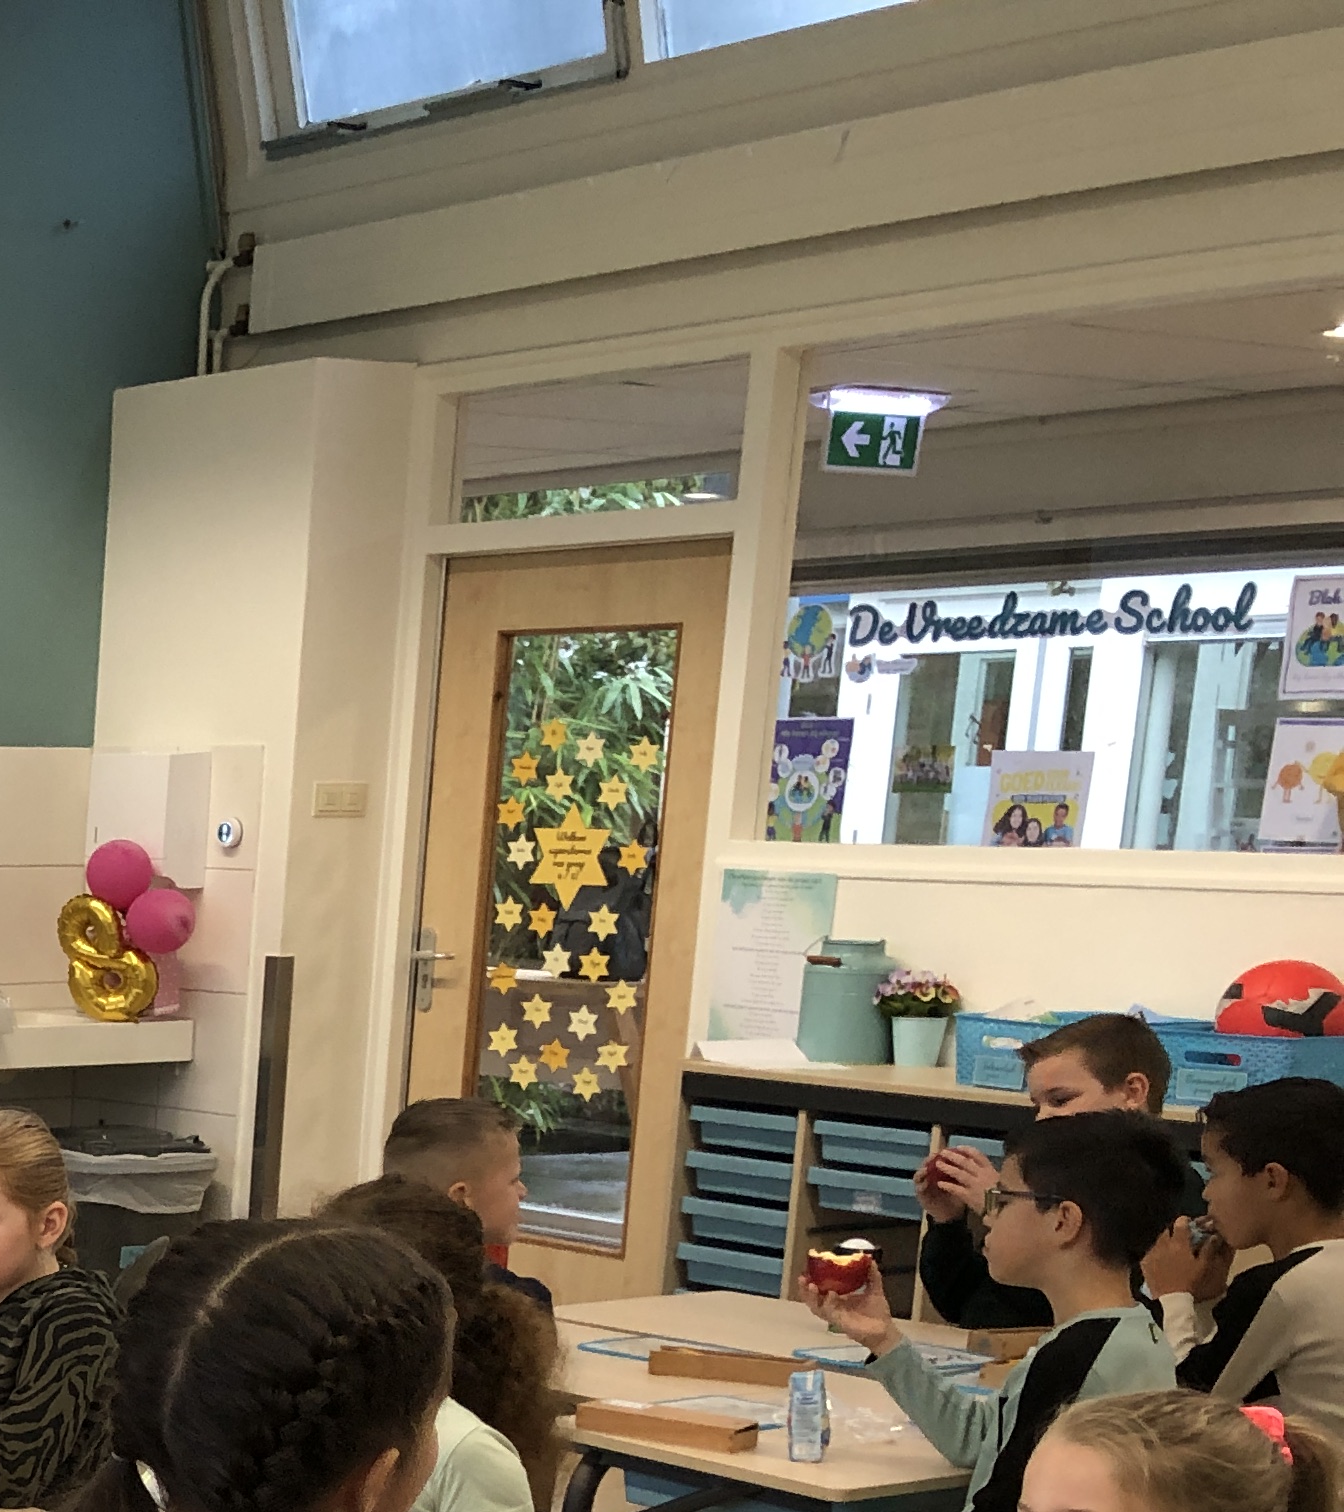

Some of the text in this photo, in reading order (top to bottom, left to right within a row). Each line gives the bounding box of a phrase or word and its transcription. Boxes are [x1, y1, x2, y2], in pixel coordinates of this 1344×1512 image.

[849, 581, 1258, 646] De Vreedzame School
